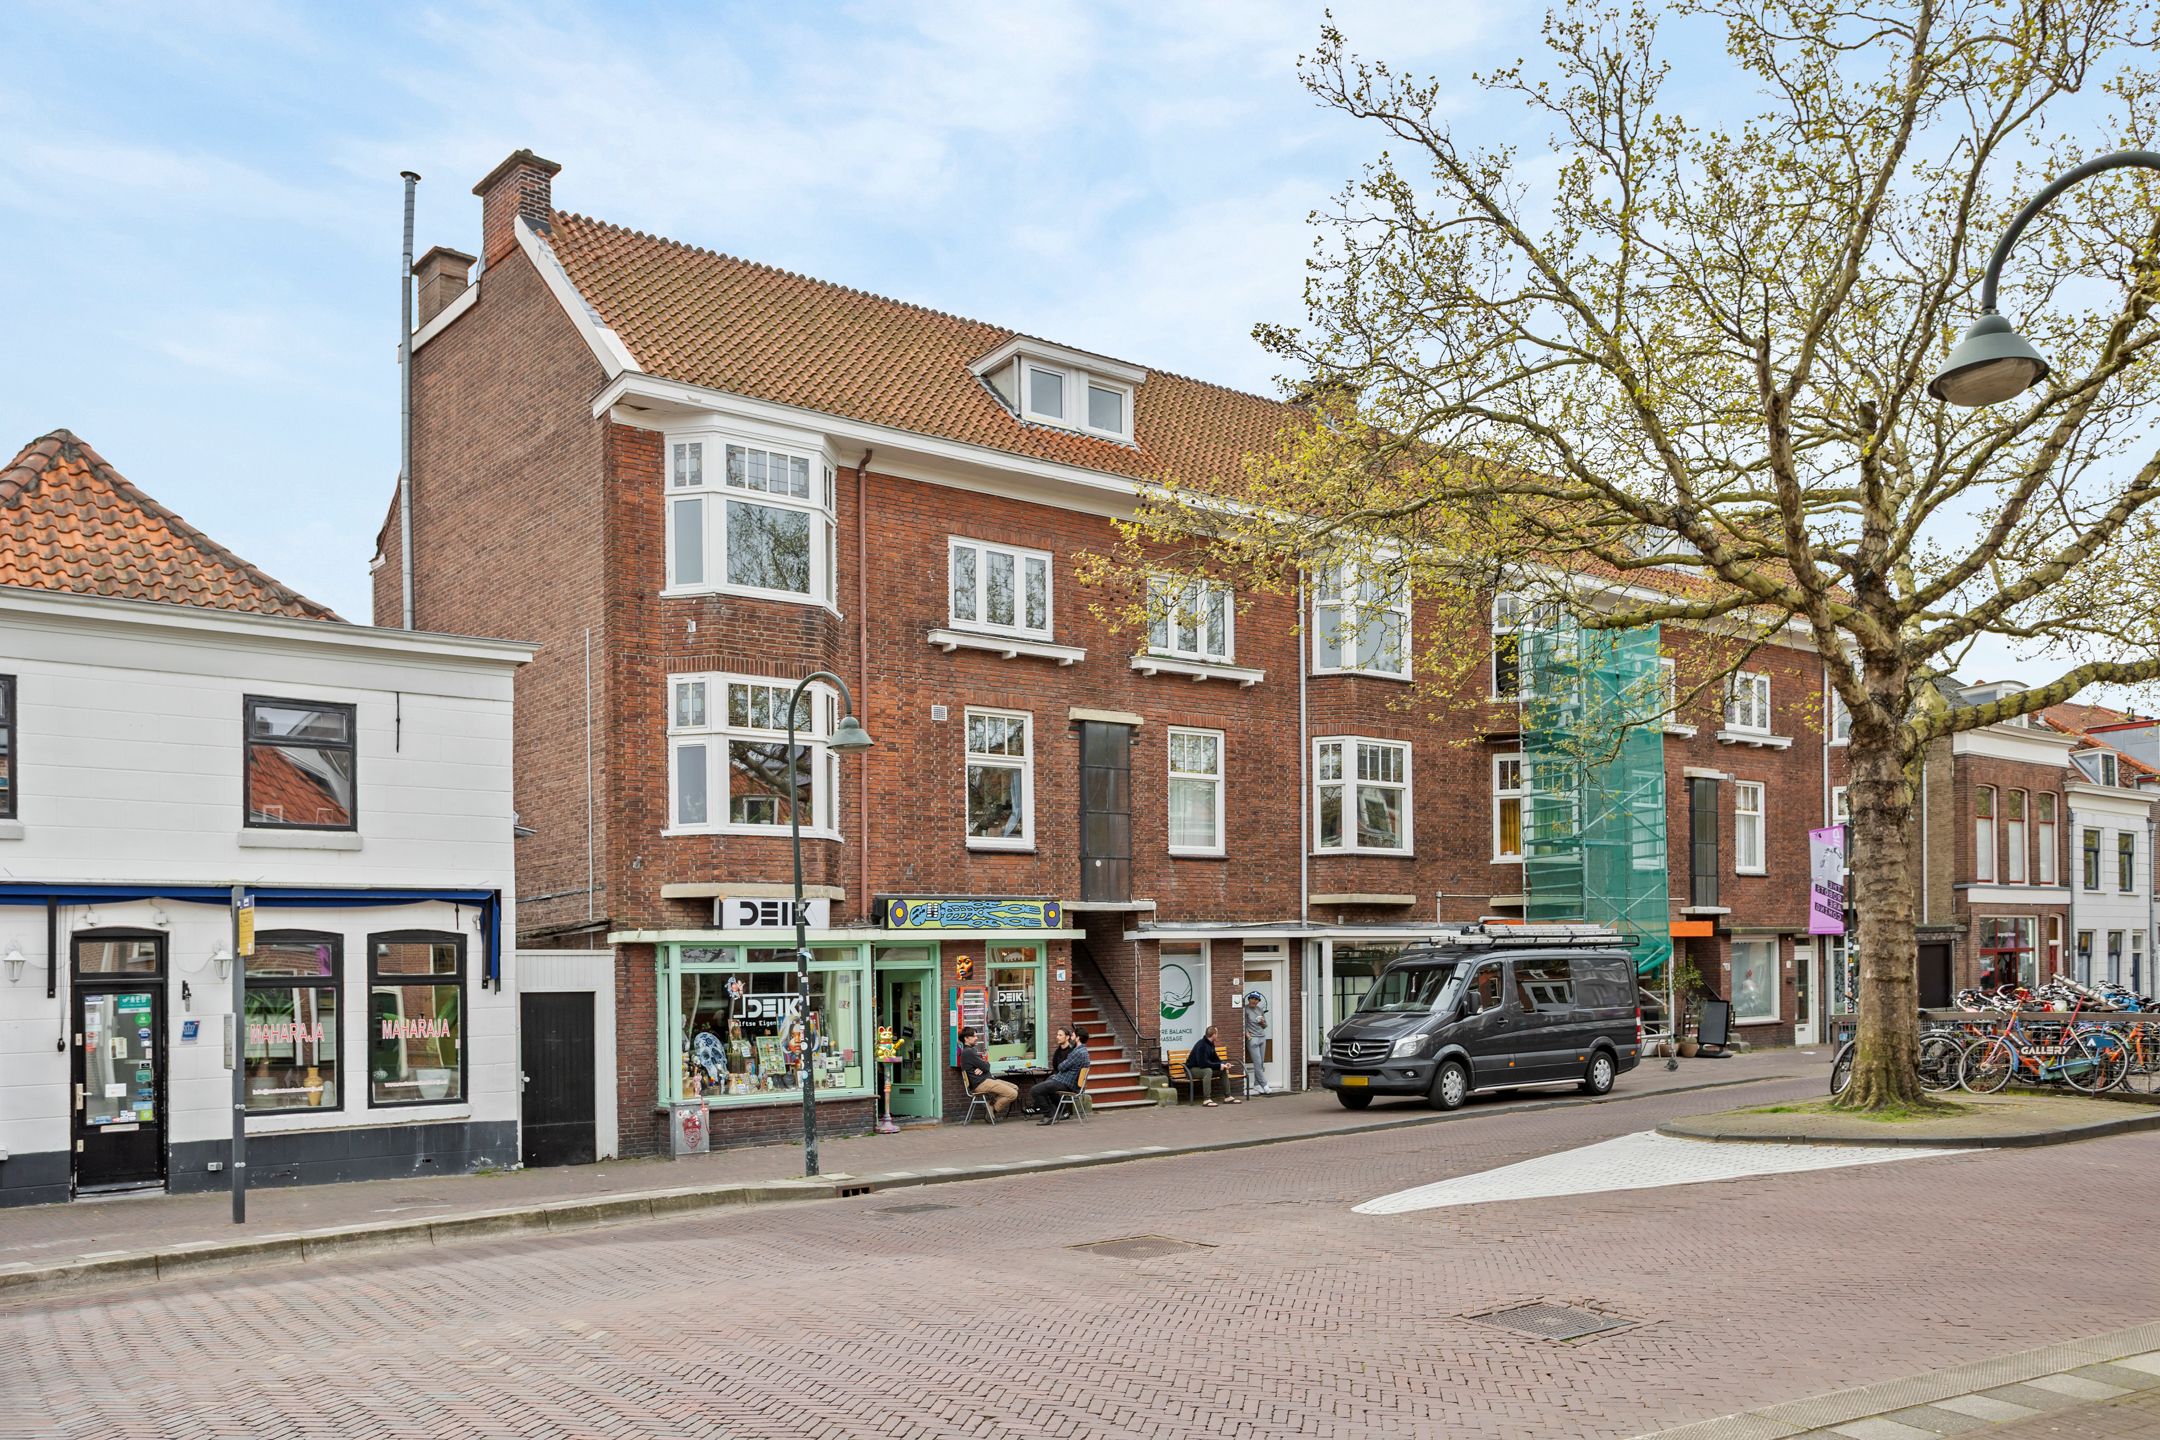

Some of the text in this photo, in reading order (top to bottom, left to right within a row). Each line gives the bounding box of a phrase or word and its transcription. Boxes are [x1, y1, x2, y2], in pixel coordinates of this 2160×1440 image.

[740, 901, 811, 926] DEIK
[1000, 992, 1023, 1002] DEIK
[747, 998, 801, 1018] DEIK
[250, 1022, 325, 1044] MAHARAJA
[382, 1018, 450, 1039] MAHARAJA
[2021, 1046, 2071, 1055] GALLERY
